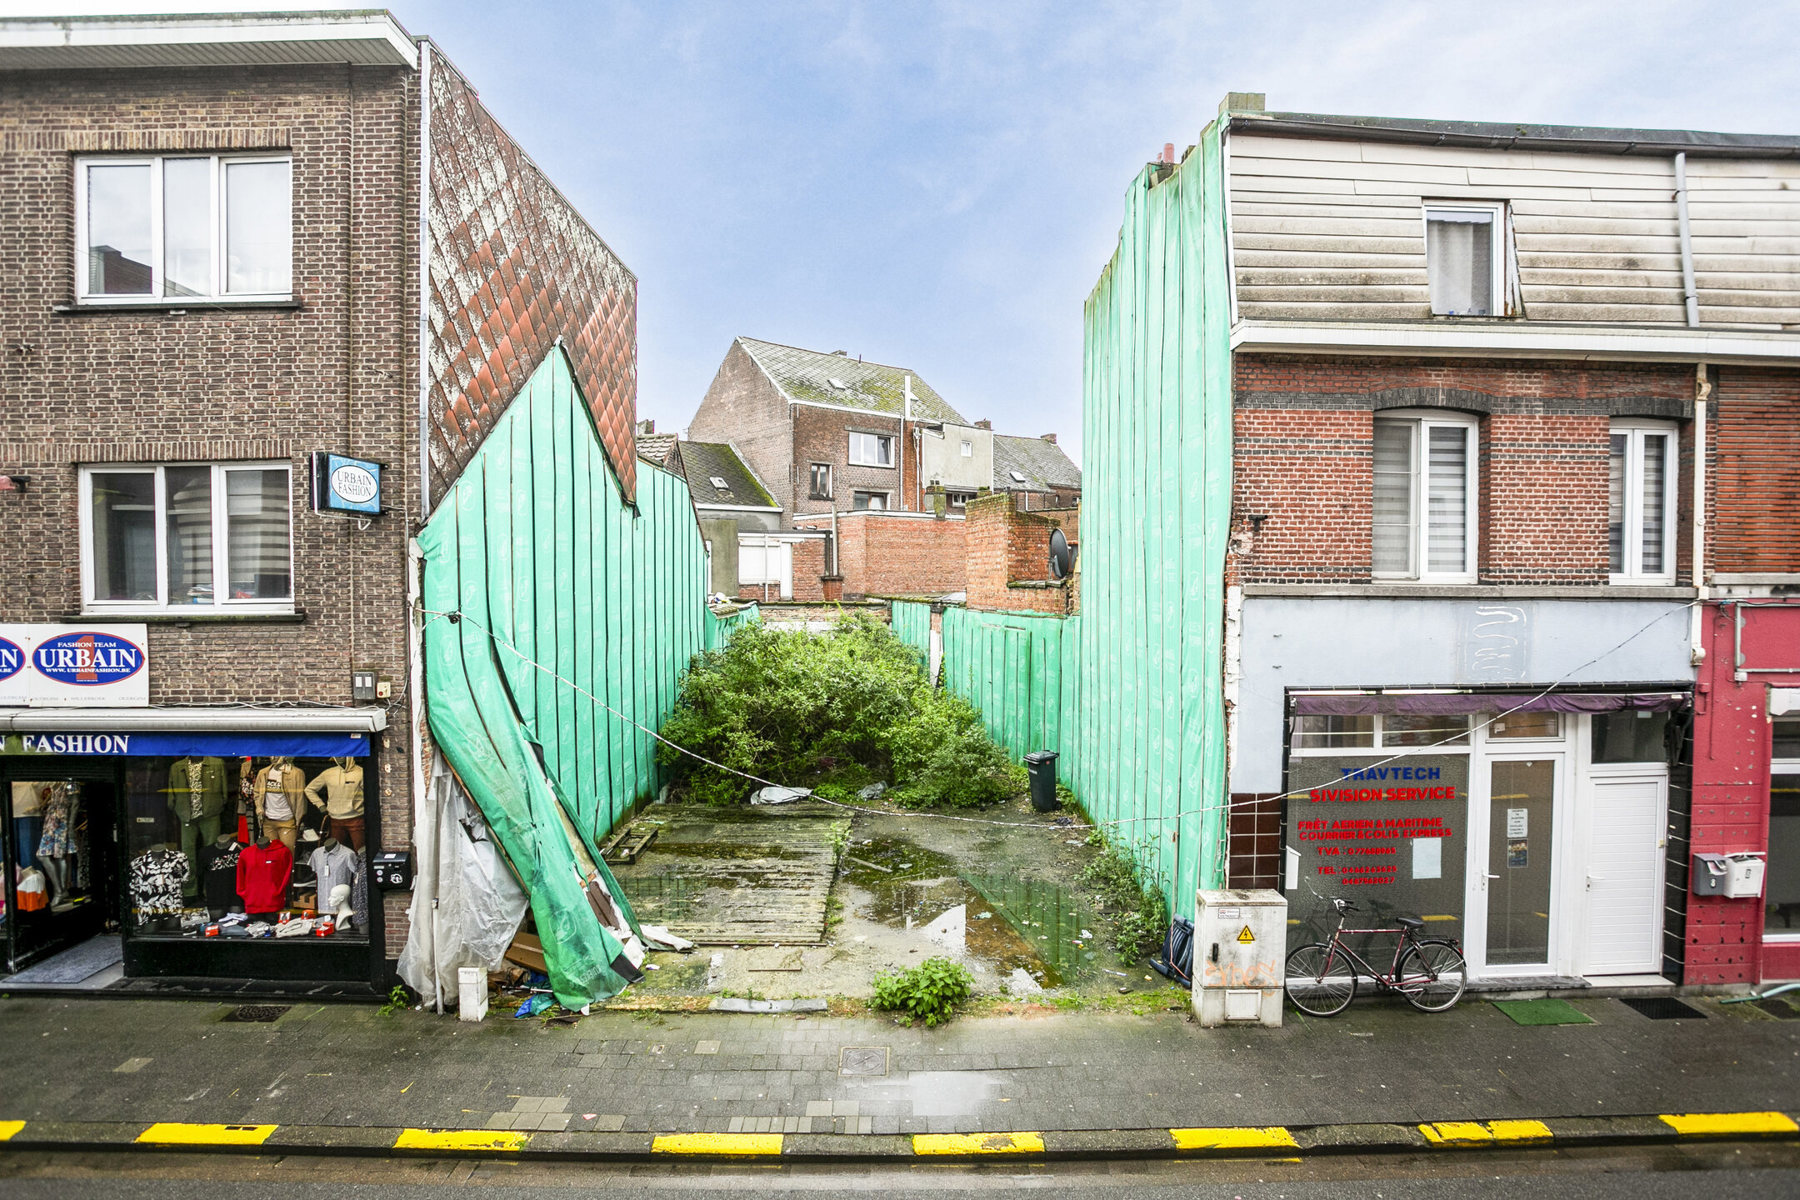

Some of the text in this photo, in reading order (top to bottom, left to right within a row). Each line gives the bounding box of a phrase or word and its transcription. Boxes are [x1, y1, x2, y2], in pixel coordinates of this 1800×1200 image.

[337, 470, 372, 486] URBAIN
[338, 482, 371, 496] FASHION
[38, 648, 137, 668] URBAIN
[22, 735, 130, 753] FASHION
[1386, 786, 1456, 801] SERVICE
[1332, 819, 1374, 831] AERIEN
[1376, 820, 1383, 829] &
[1385, 817, 1443, 829] MARITIME
[1403, 828, 1453, 839] EXPRESS
